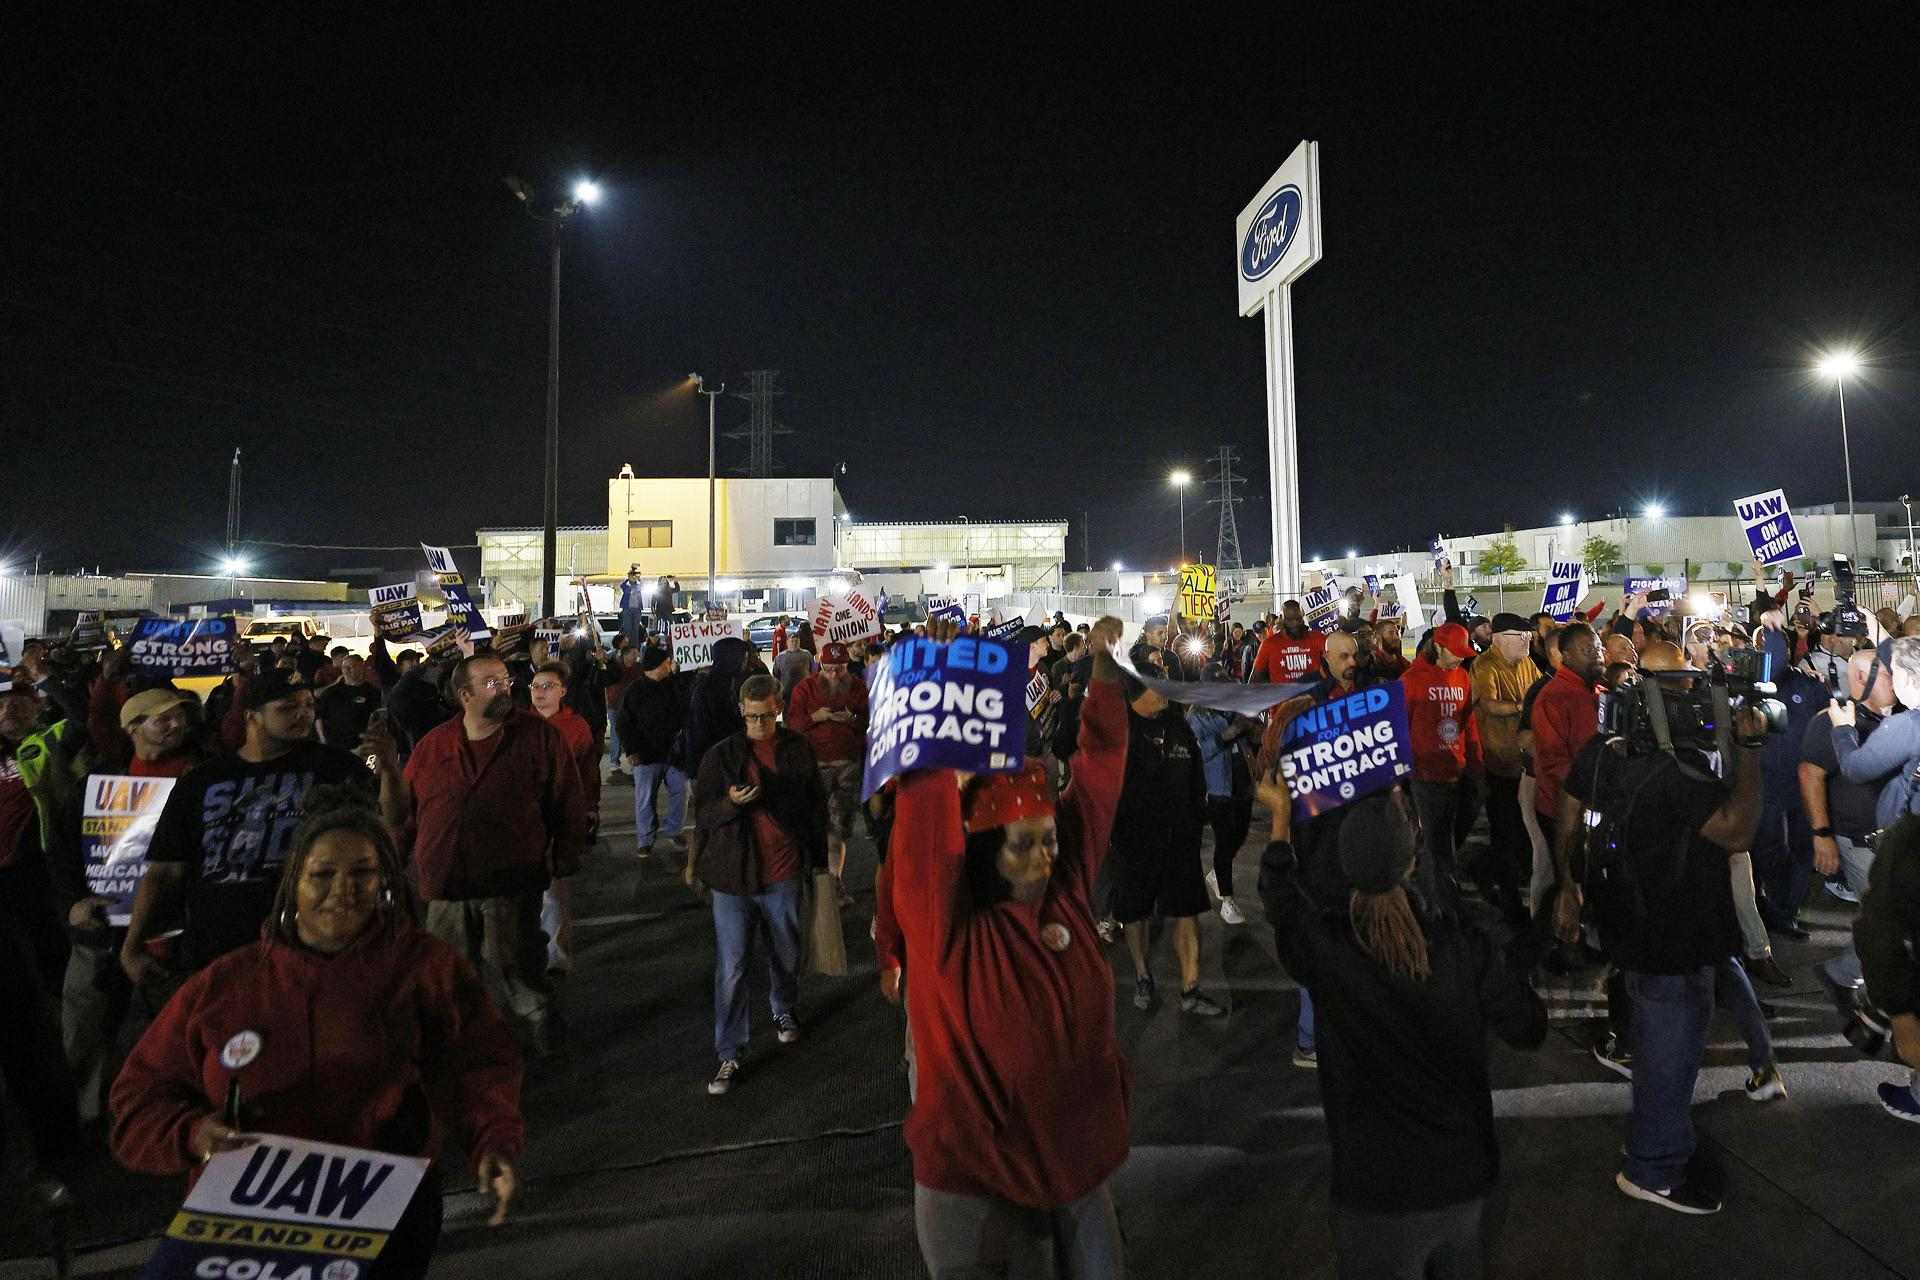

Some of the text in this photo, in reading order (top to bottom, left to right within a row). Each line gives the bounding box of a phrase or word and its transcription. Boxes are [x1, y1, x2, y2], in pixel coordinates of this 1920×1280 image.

[1252, 203, 1288, 269] Ford
[1738, 496, 1782, 521] UAW
[1760, 521, 1779, 541] ON
[1756, 530, 1797, 562] STRIKE
[1552, 561, 1582, 578] UAW
[376, 585, 408, 602] UAW
[1182, 575, 1214, 594] ALL
[1556, 584, 1570, 600] ON
[451, 602, 472, 613] PAY
[1182, 593, 1214, 617] TIERS
[1305, 587, 1332, 609] UAW
[814, 598, 834, 637] MANY
[835, 608, 852, 622] ONE
[1544, 602, 1576, 616] STRIKE
[674, 624, 697, 640] get
[829, 619, 869, 641] UNION!
[134, 640, 227, 657] STRONG
[889, 637, 1009, 676] NITED
[131, 653, 229, 668] CONTRACT
[1286, 655, 1307, 671] UAW
[1428, 687, 1464, 701] STAND
[1440, 703, 1457, 717] UP
[870, 713, 1007, 767] CONTRACT
[1280, 720, 1394, 778] STRONG
[1287, 742, 1398, 800] CONTRACT
[95, 780, 160, 811] UAW
[85, 818, 121, 833] STAN
[85, 863, 150, 878] MERICAN
[230, 1146, 395, 1220] UAW
[183, 1220, 374, 1252] STAND UP
[194, 1255, 313, 1280] COLA
